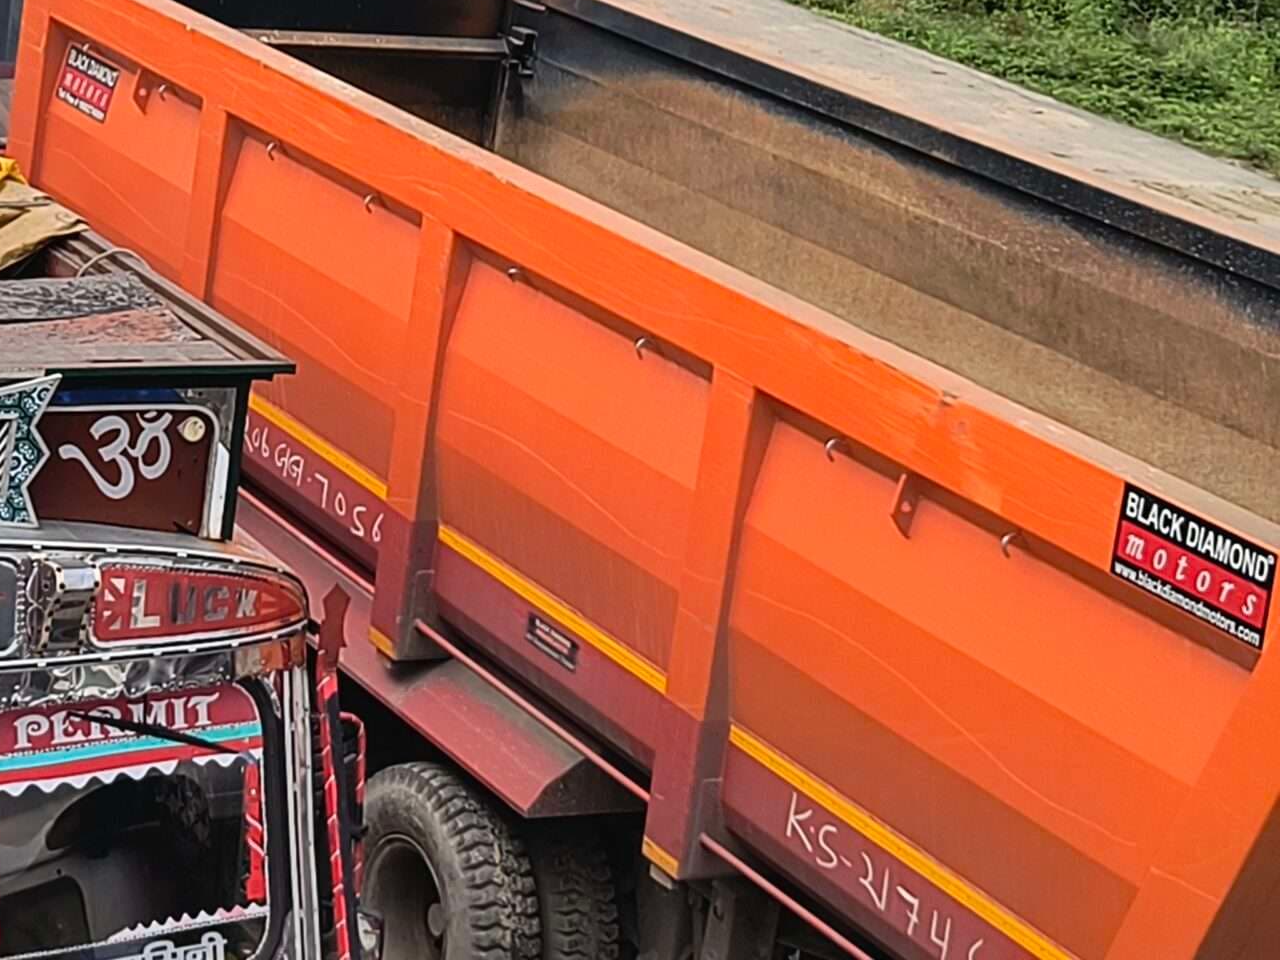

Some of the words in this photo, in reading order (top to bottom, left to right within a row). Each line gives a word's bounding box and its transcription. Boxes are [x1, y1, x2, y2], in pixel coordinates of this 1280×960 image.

[1125, 491, 1186, 542] BLACK
[129, 577, 258, 630] LUCK
[1114, 561, 1261, 647] www.blackdiamondmotors.com
[1124, 534, 1258, 616] motors
[13, 691, 220, 750] PERMIT
